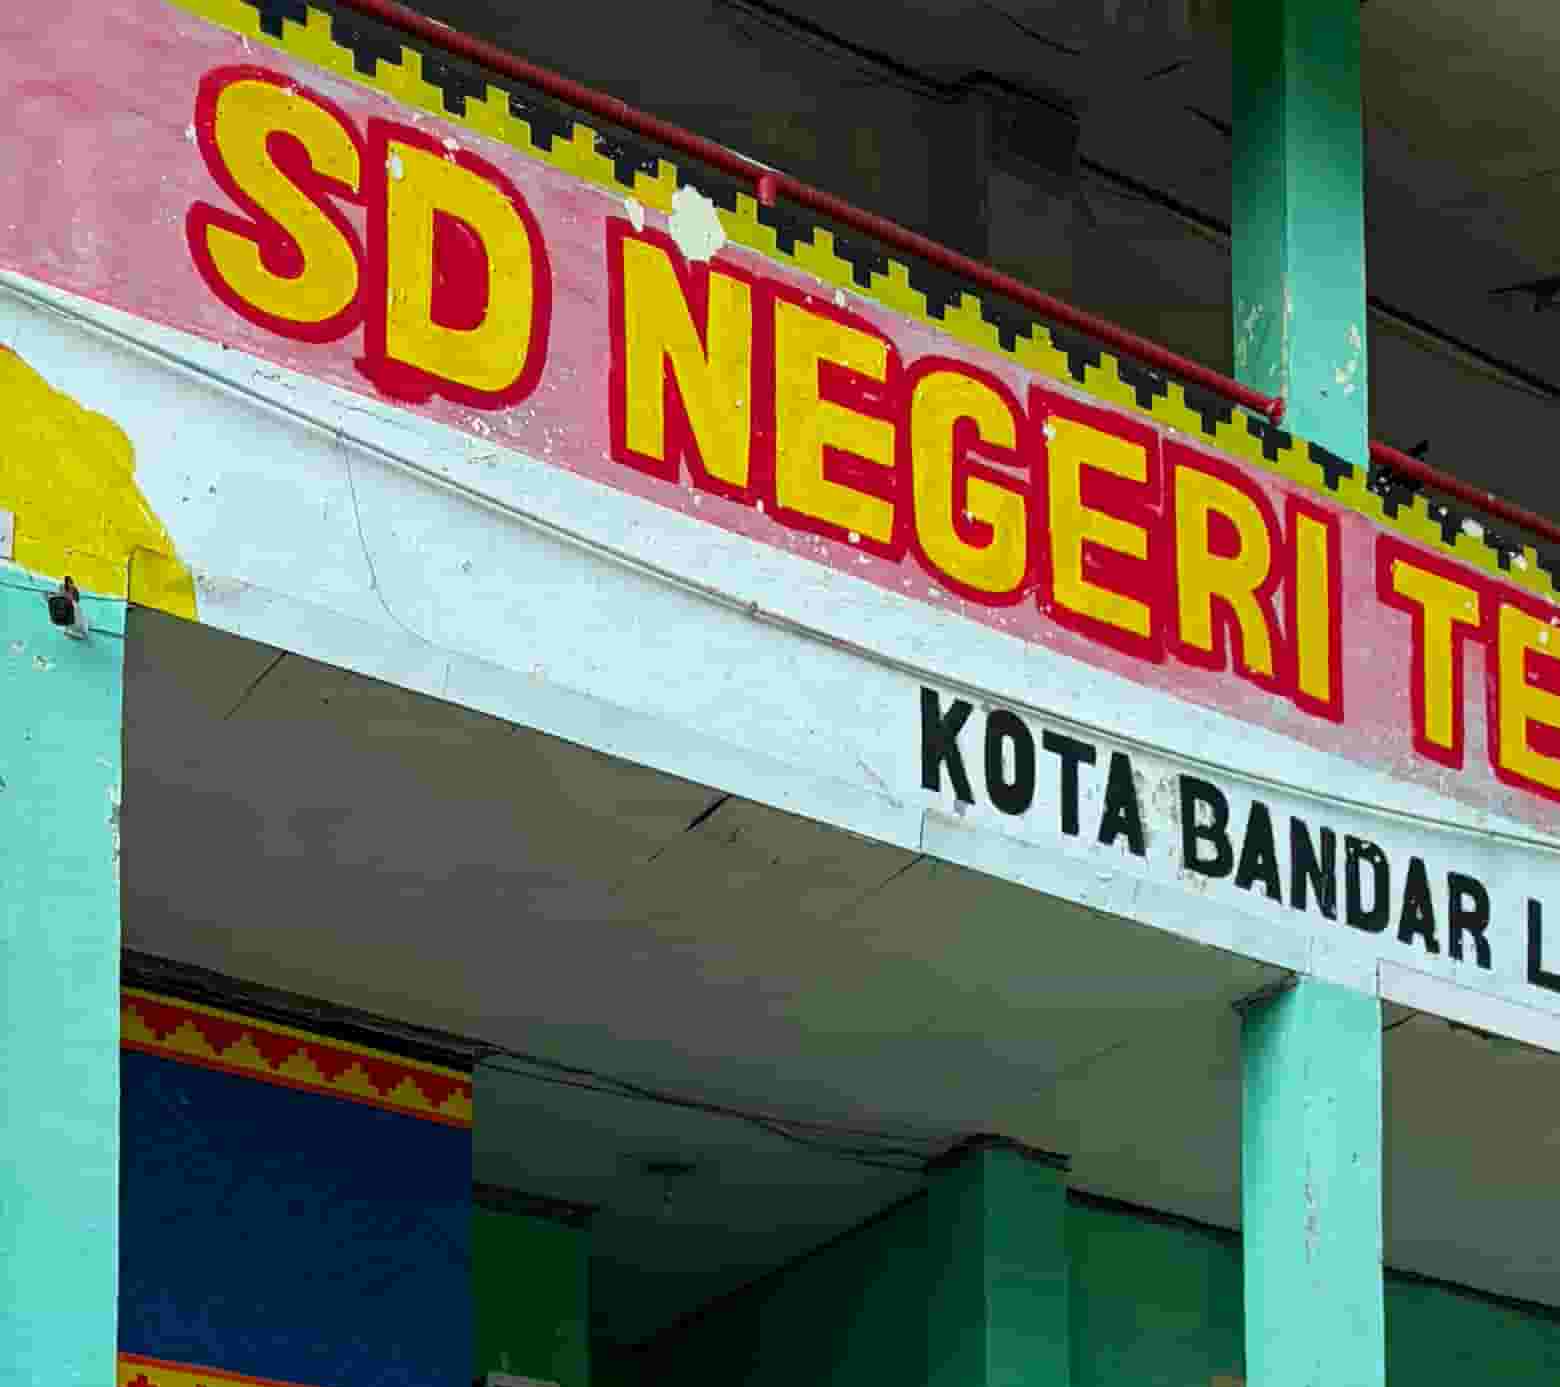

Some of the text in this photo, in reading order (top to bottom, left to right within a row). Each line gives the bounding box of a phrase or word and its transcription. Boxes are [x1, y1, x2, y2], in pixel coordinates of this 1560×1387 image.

[186, 64, 552, 410] SD
[606, 216, 1344, 723] NEGERI
[920, 686, 1147, 857] KOTA
[1179, 774, 1493, 969] BANDAR
